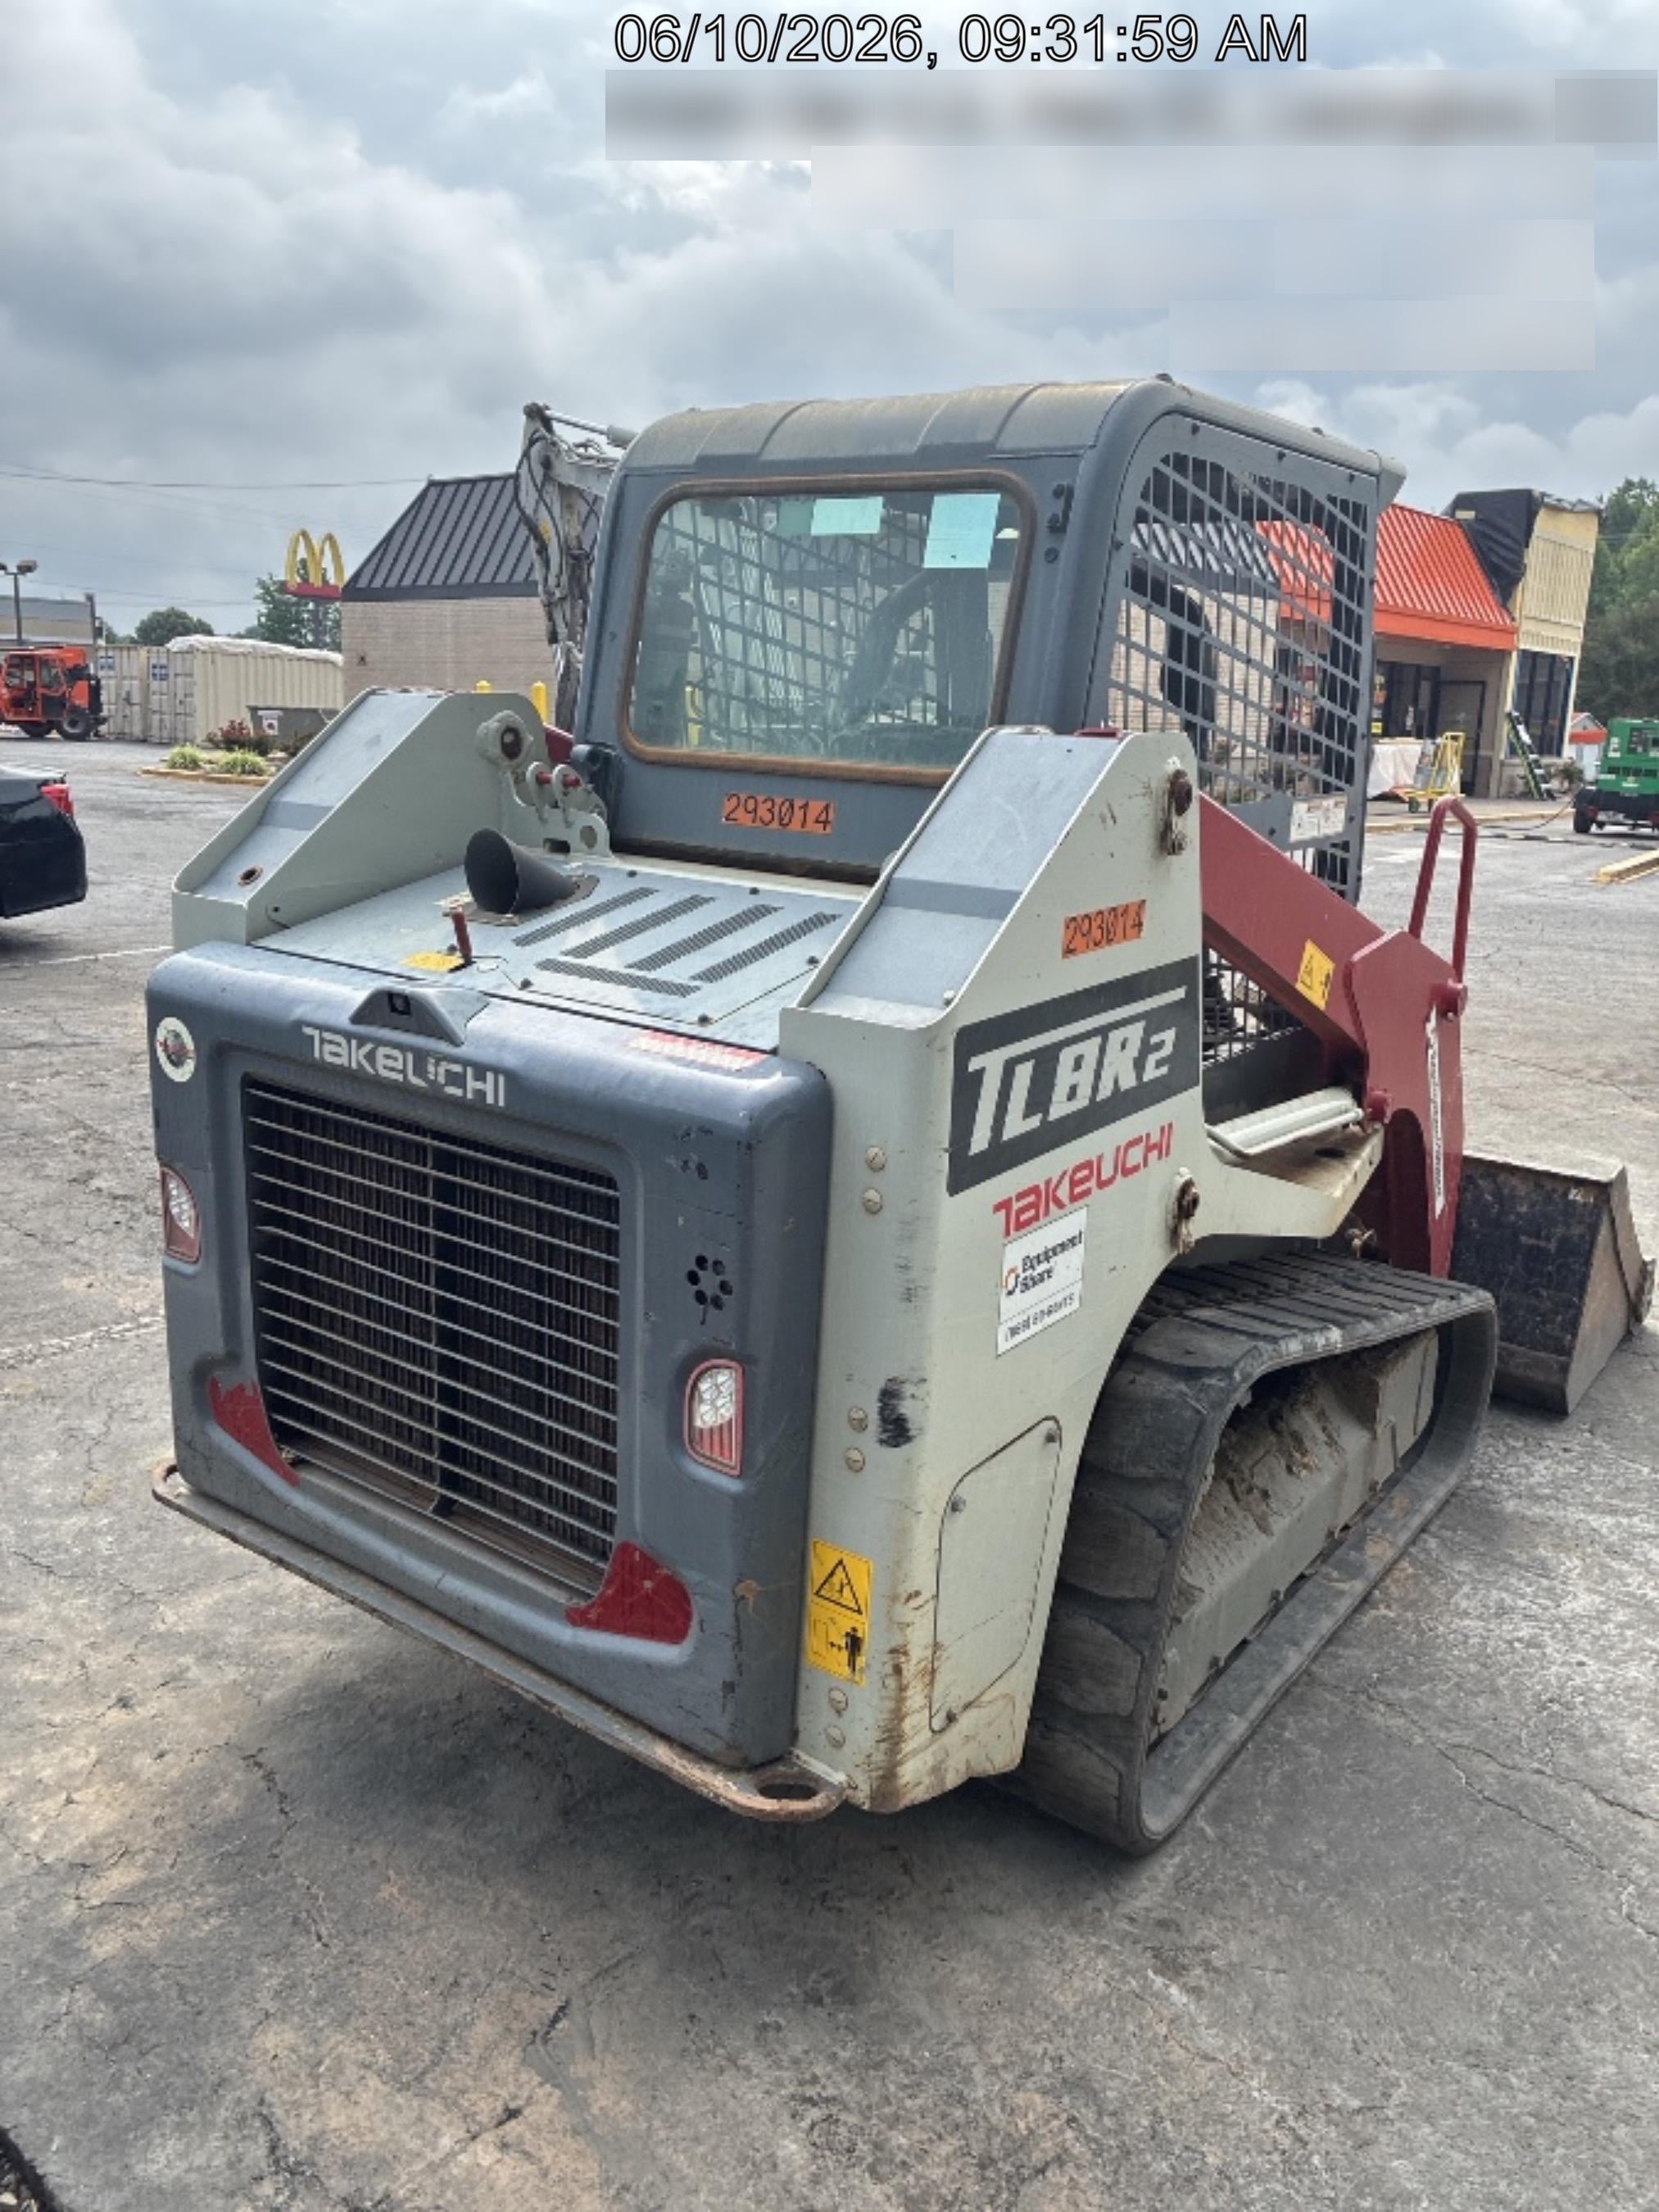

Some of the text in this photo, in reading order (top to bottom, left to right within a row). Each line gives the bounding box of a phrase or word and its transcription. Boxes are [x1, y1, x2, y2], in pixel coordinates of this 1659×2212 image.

[723, 792, 832, 832] 293014
[1063, 900, 1145, 957] 293014
[992, 1122, 1173, 1239] TAKEUCHI
